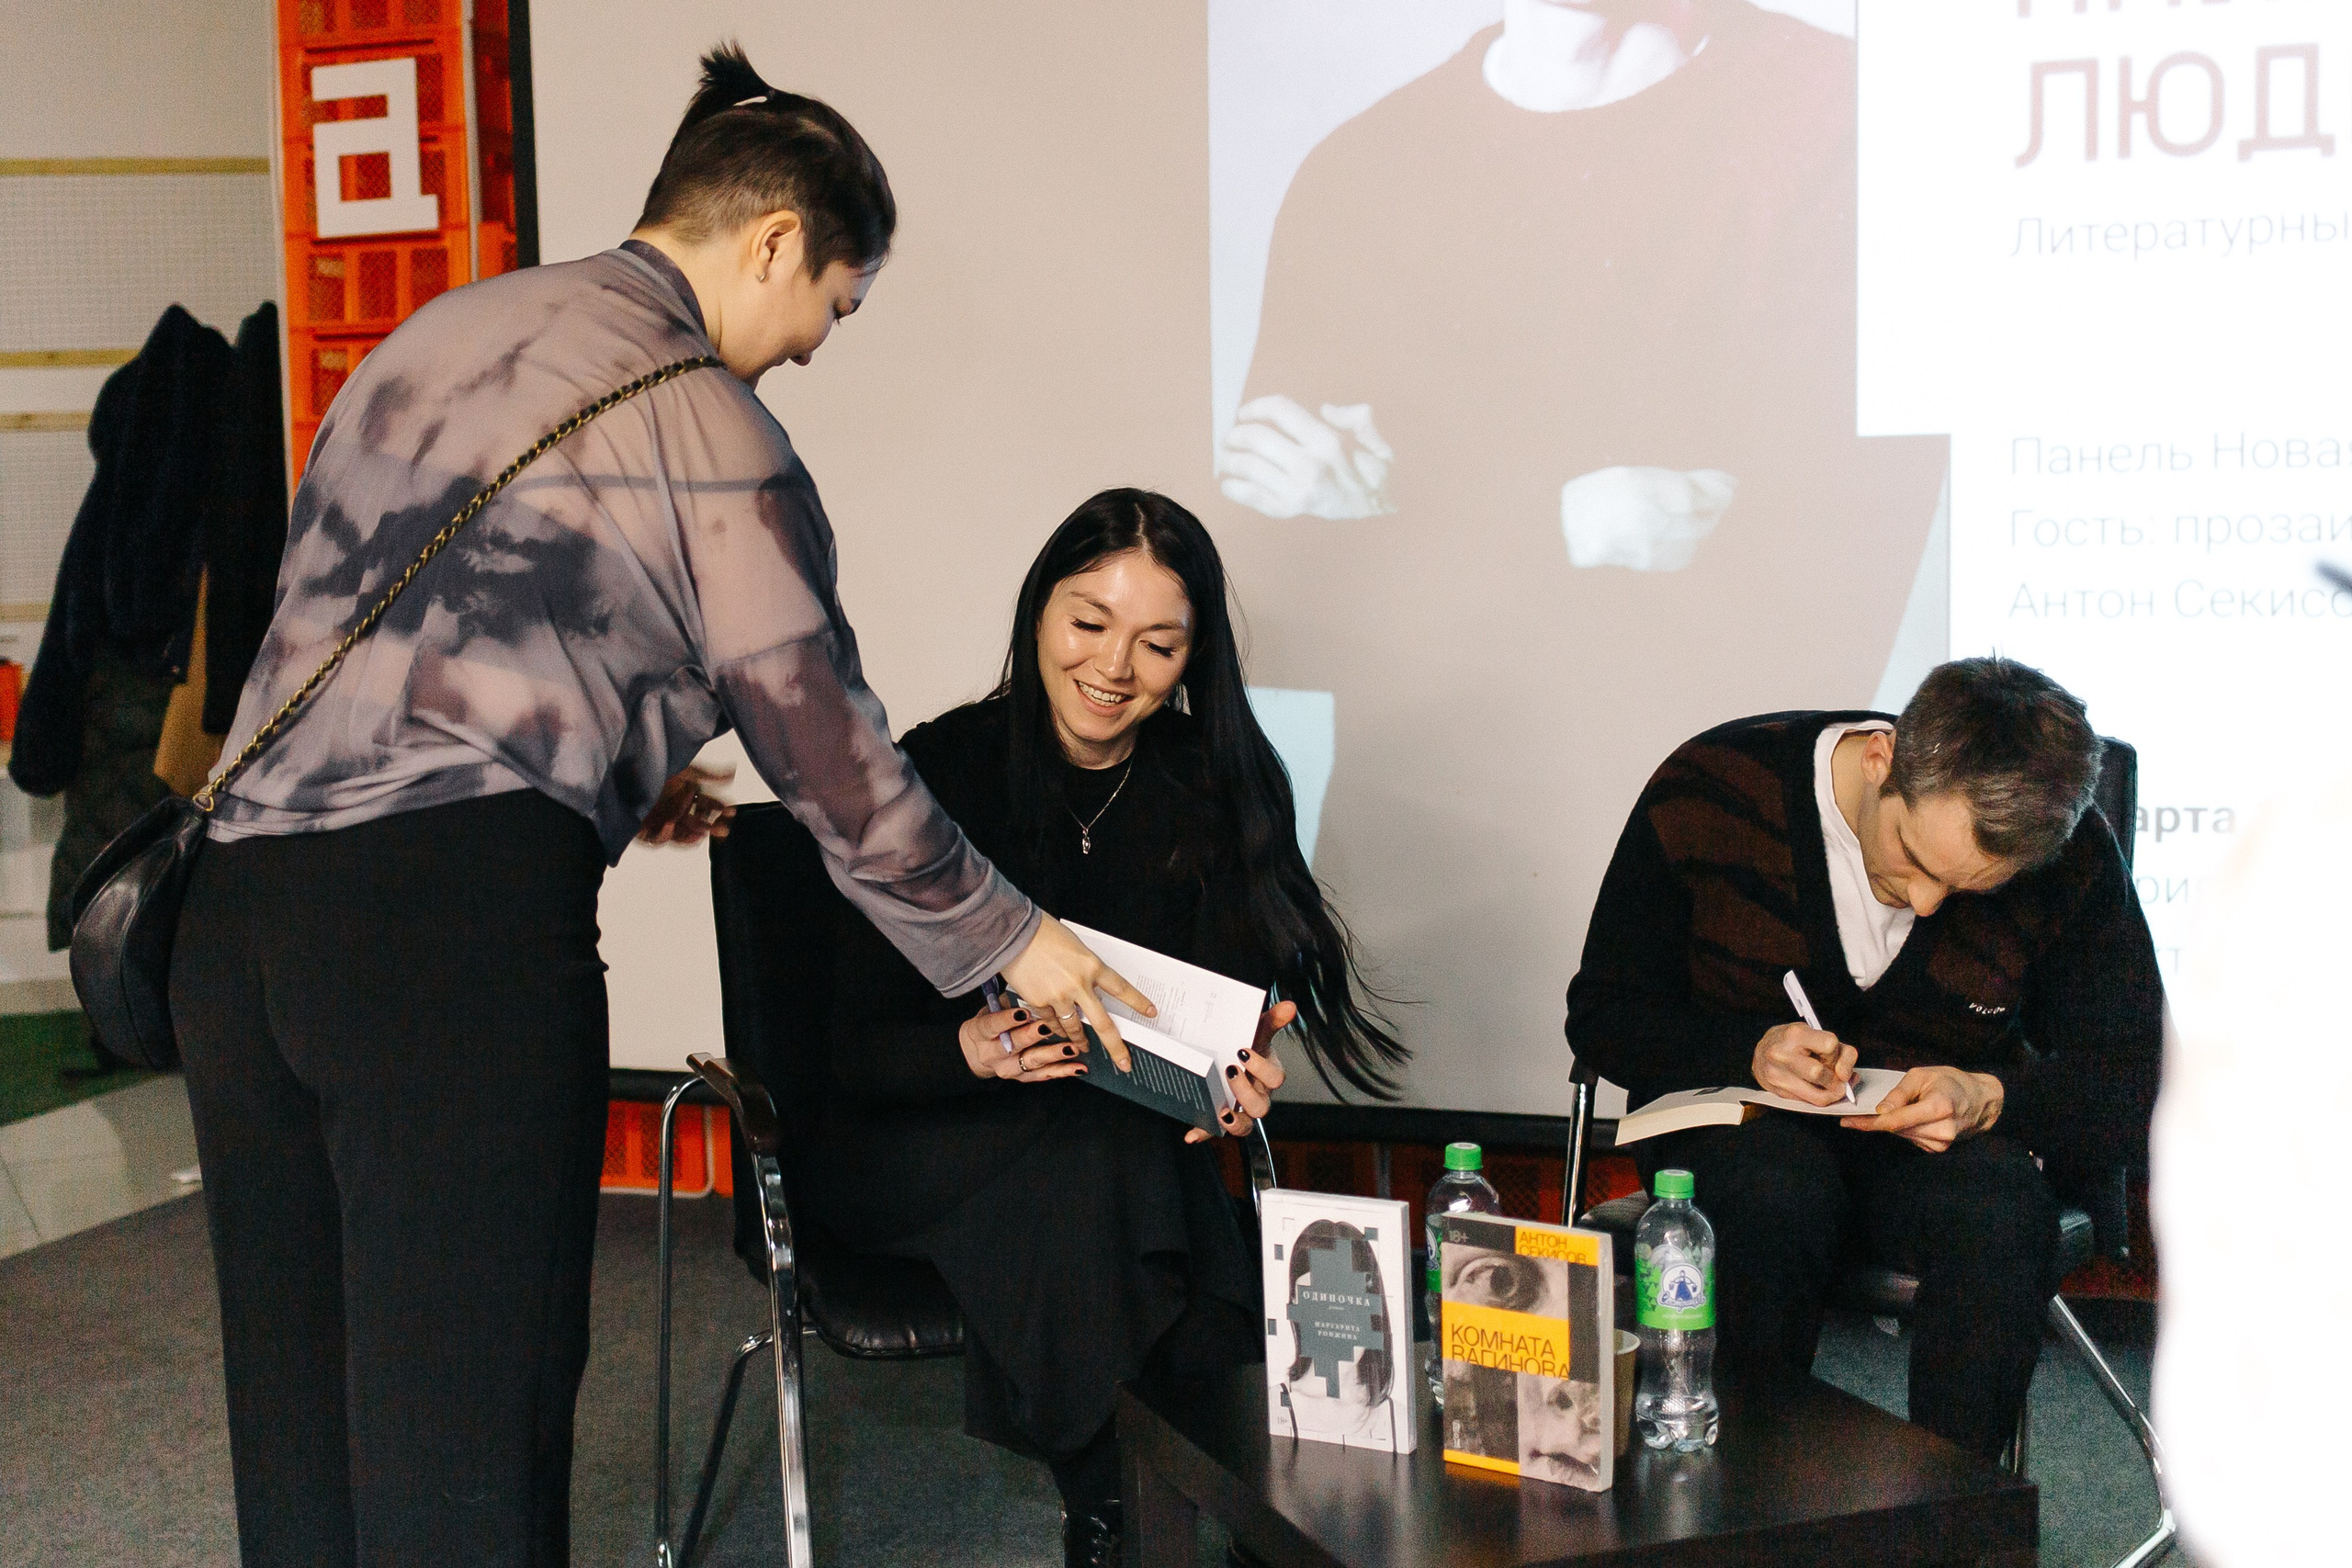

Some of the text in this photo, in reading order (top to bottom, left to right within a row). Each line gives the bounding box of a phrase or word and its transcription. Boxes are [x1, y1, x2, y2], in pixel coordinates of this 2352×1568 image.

[2014, 42, 2352, 169] ЛЮД
[2011, 431, 2352, 475] Панель Нова
[2011, 509, 2156, 547] Гость:
[2008, 581, 2155, 618] Антон
[2136, 805, 2236, 842] арта
[1449, 1229, 1469, 1244] 18+
[1520, 1232, 1567, 1249] АНТОН
[1303, 1291, 1371, 1307] ОДИНОЧКА
[1452, 1323, 1555, 1359] КОМНАТА
[1452, 1344, 1569, 1379] ВАГИНОВА
